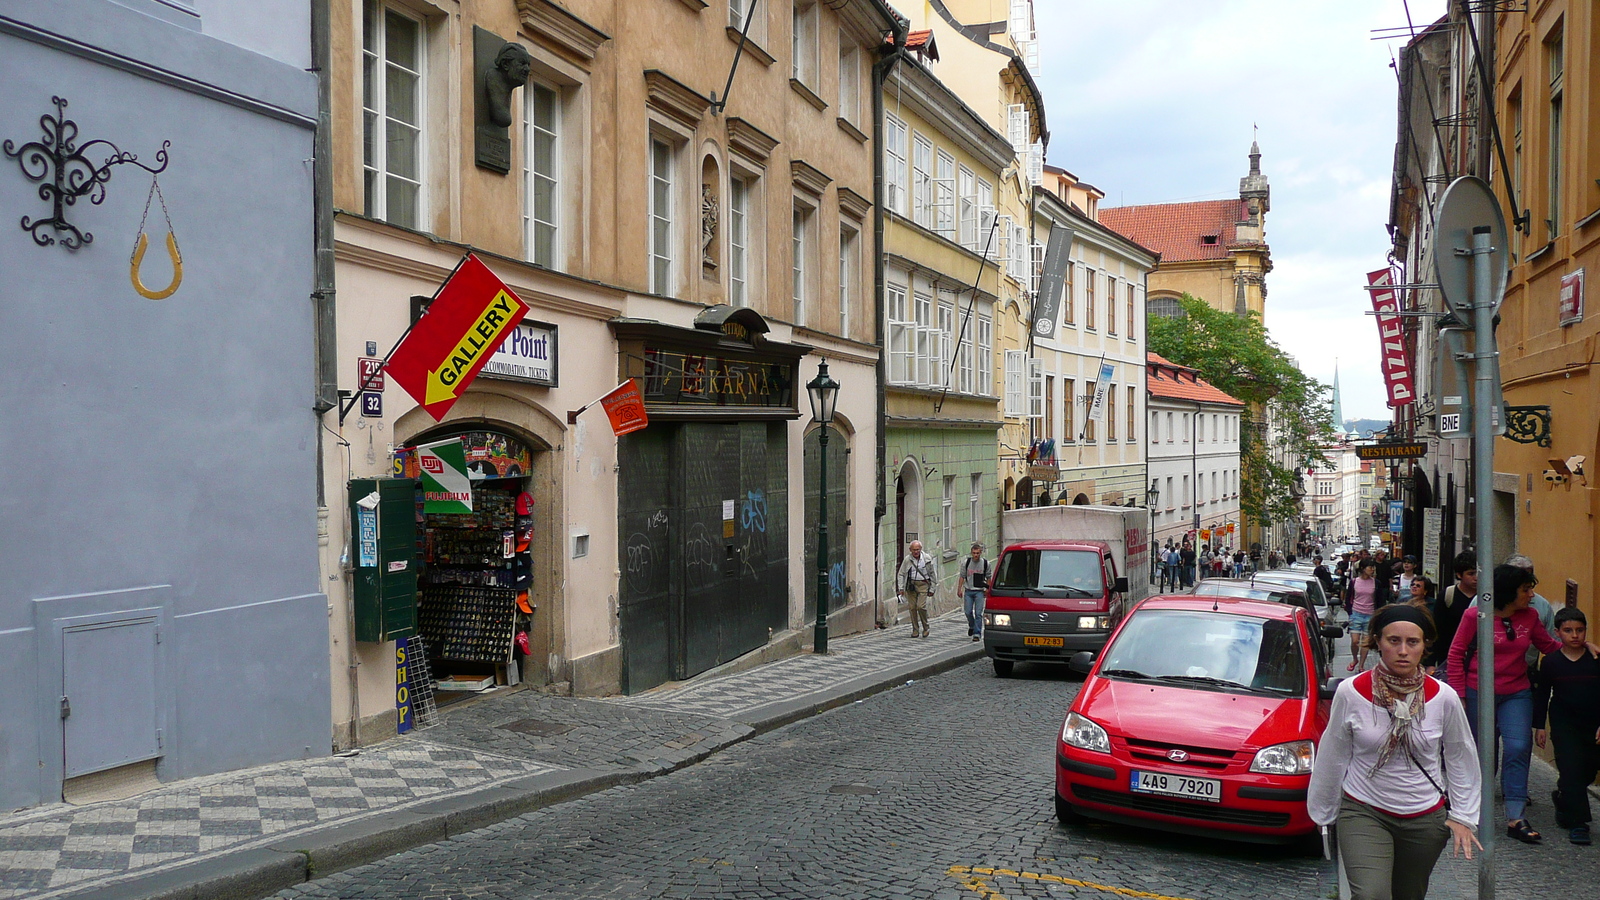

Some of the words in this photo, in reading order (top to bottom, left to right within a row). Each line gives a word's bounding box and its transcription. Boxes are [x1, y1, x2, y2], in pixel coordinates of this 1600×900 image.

[439, 295, 512, 387] GALLERY
[511, 325, 548, 361] Point
[1372, 272, 1411, 400] PIZZERIA
[528, 366, 549, 379] TICKETS
[367, 396, 380, 411] 32
[1094, 388, 1105, 408] MARE
[1442, 415, 1459, 431] BNE
[1361, 445, 1423, 457] RESTAURANT
[425, 491, 470, 502] FUJIFILM
[1027, 637, 1039, 645] AKA
[396, 647, 409, 724] SHOP
[1142, 774, 1168, 790] 4A9
[1178, 778, 1214, 796] 7920
